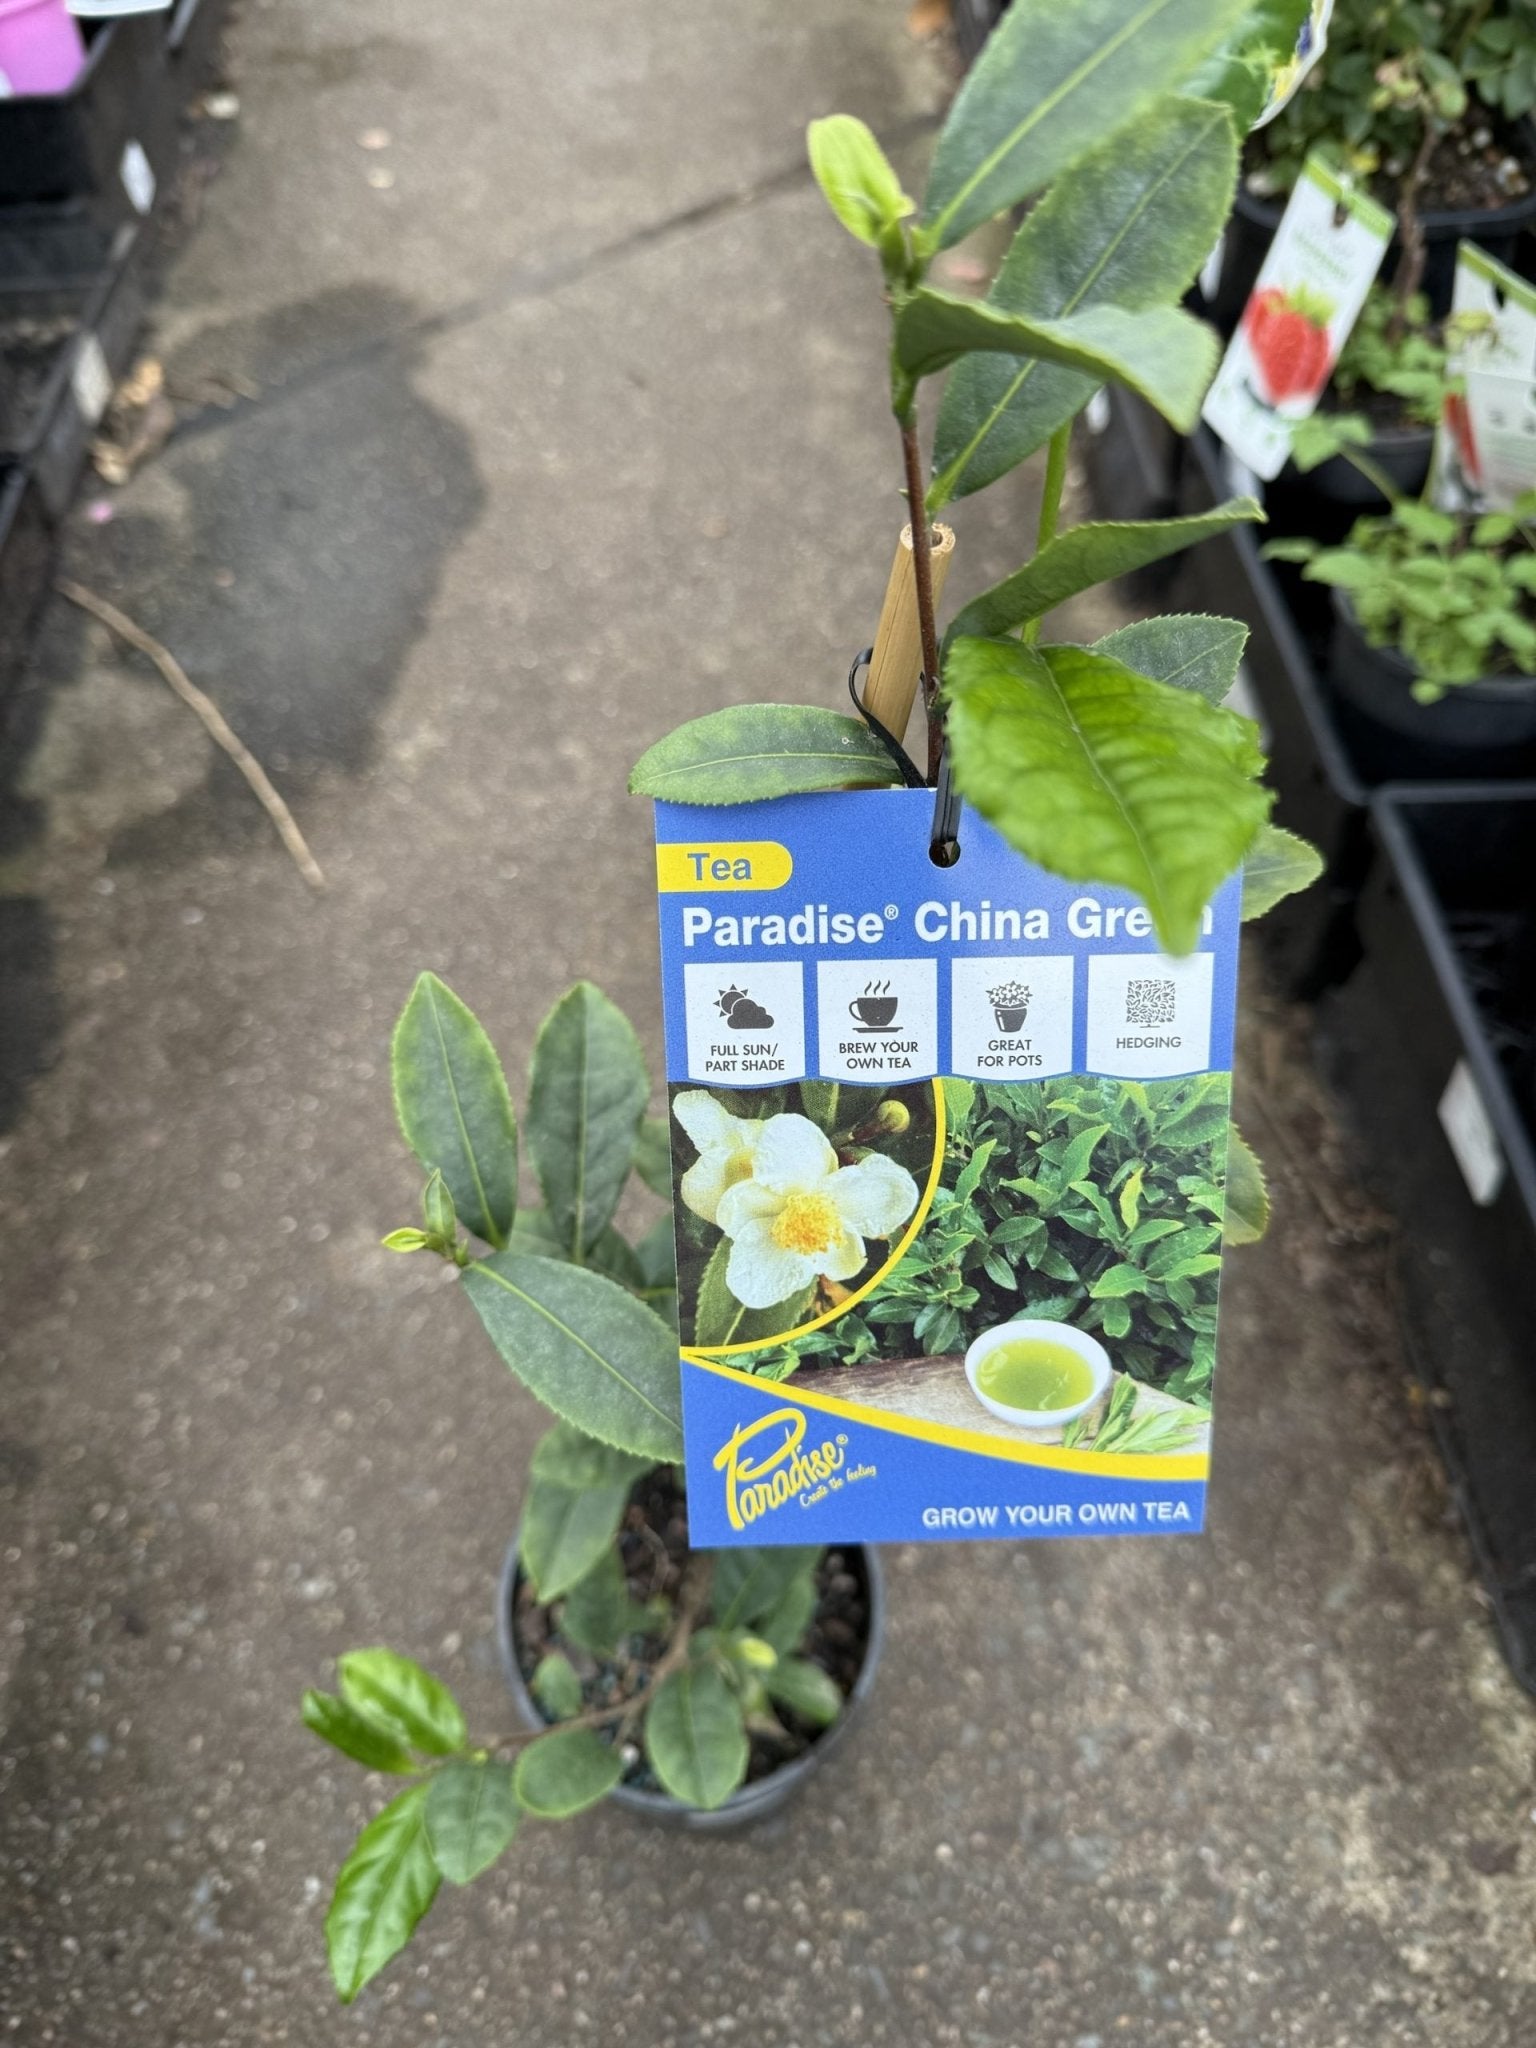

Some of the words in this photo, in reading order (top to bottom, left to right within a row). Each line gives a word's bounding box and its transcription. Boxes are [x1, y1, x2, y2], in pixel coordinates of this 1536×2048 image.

[687, 852, 752, 881] Tea
[914, 900, 1049, 942] China
[1067, 898, 1213, 939] Gre
[839, 1042, 879, 1054] BREW
[880, 1041, 919, 1053] YOUR
[988, 1039, 1032, 1051] GREAT
[1116, 1037, 1182, 1049] HEDGING
[710, 1044, 739, 1057] FULL
[743, 1043, 778, 1058] SUN/
[705, 1060, 738, 1072] PART
[741, 1059, 785, 1072] SHADE
[846, 1057, 884, 1069] OWN
[887, 1057, 912, 1069] TEA
[977, 1055, 1004, 1067] FOR
[1008, 1055, 1043, 1067] POTS
[922, 1505, 998, 1527] GROW
[1005, 1504, 1072, 1525] YOUR
[1078, 1502, 1137, 1522] OWN
[1142, 1501, 1190, 1520] TEA
